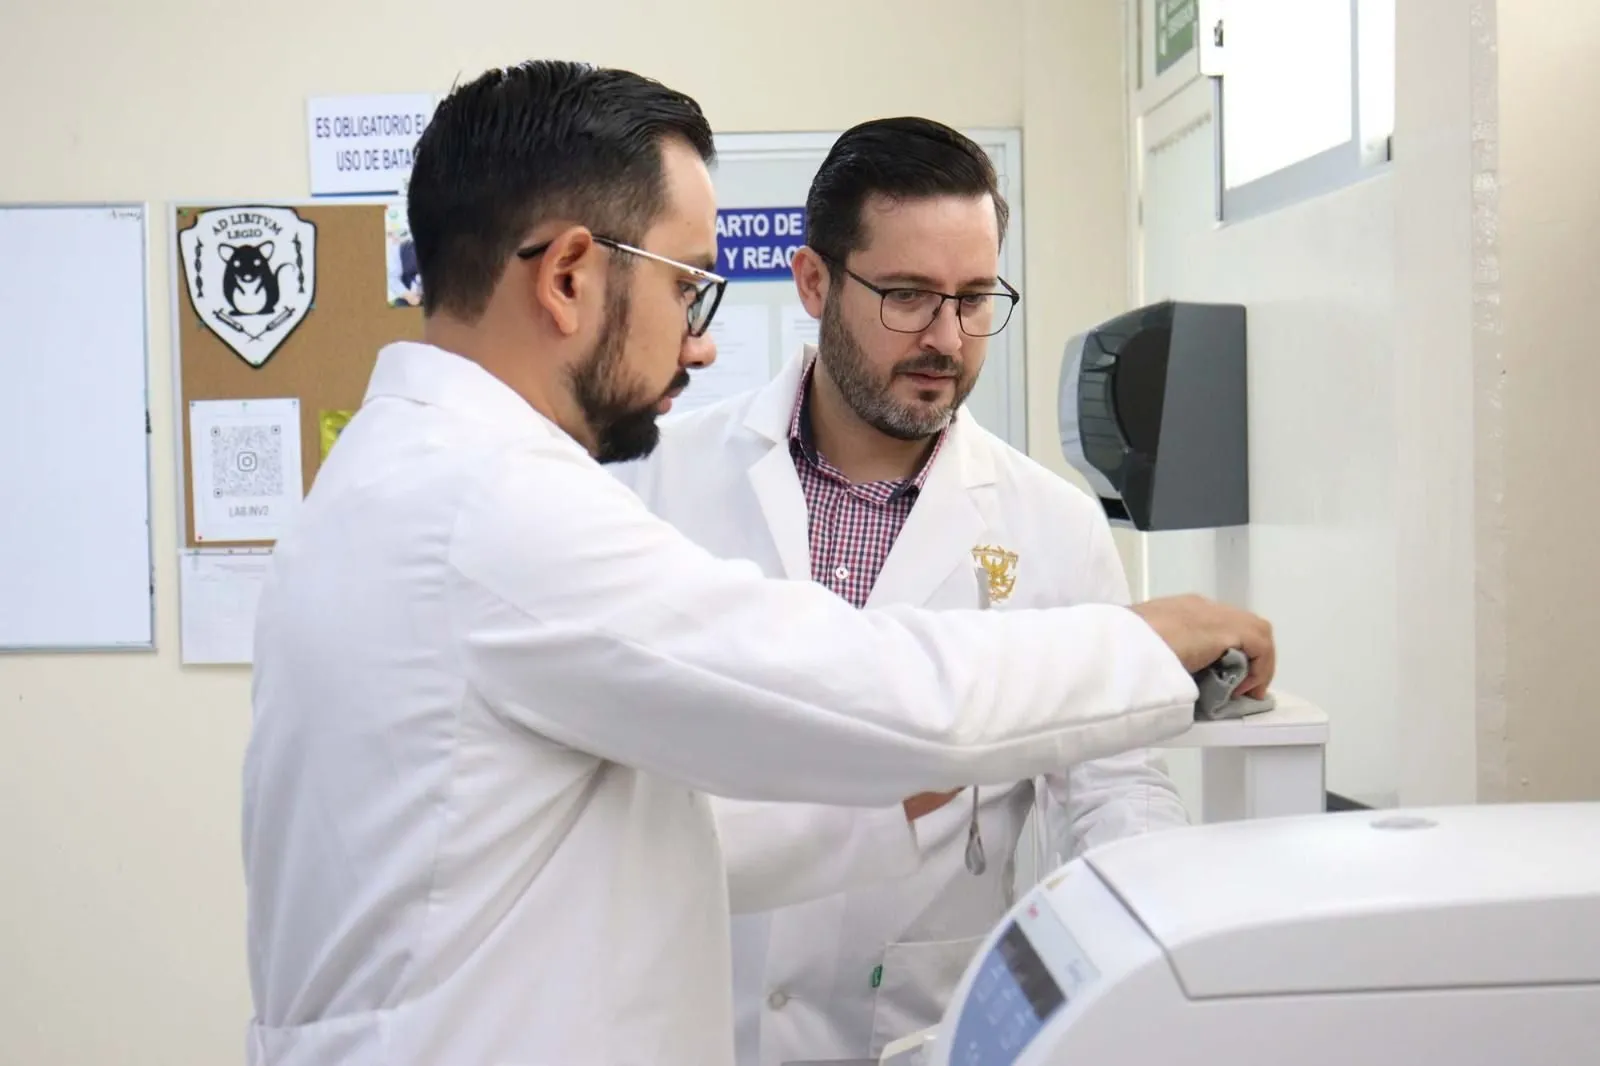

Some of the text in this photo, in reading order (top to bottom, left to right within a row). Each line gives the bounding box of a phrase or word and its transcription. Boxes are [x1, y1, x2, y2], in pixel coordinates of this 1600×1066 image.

[316, 117, 330, 138] ES
[334, 114, 412, 137] OBLIGATORIO
[336, 150, 361, 171] USO
[364, 149, 379, 170] DE
[212, 218, 228, 236] AD
[227, 228, 263, 239] LEGIO
[774, 213, 803, 235] DE
[723, 247, 739, 270] Y
